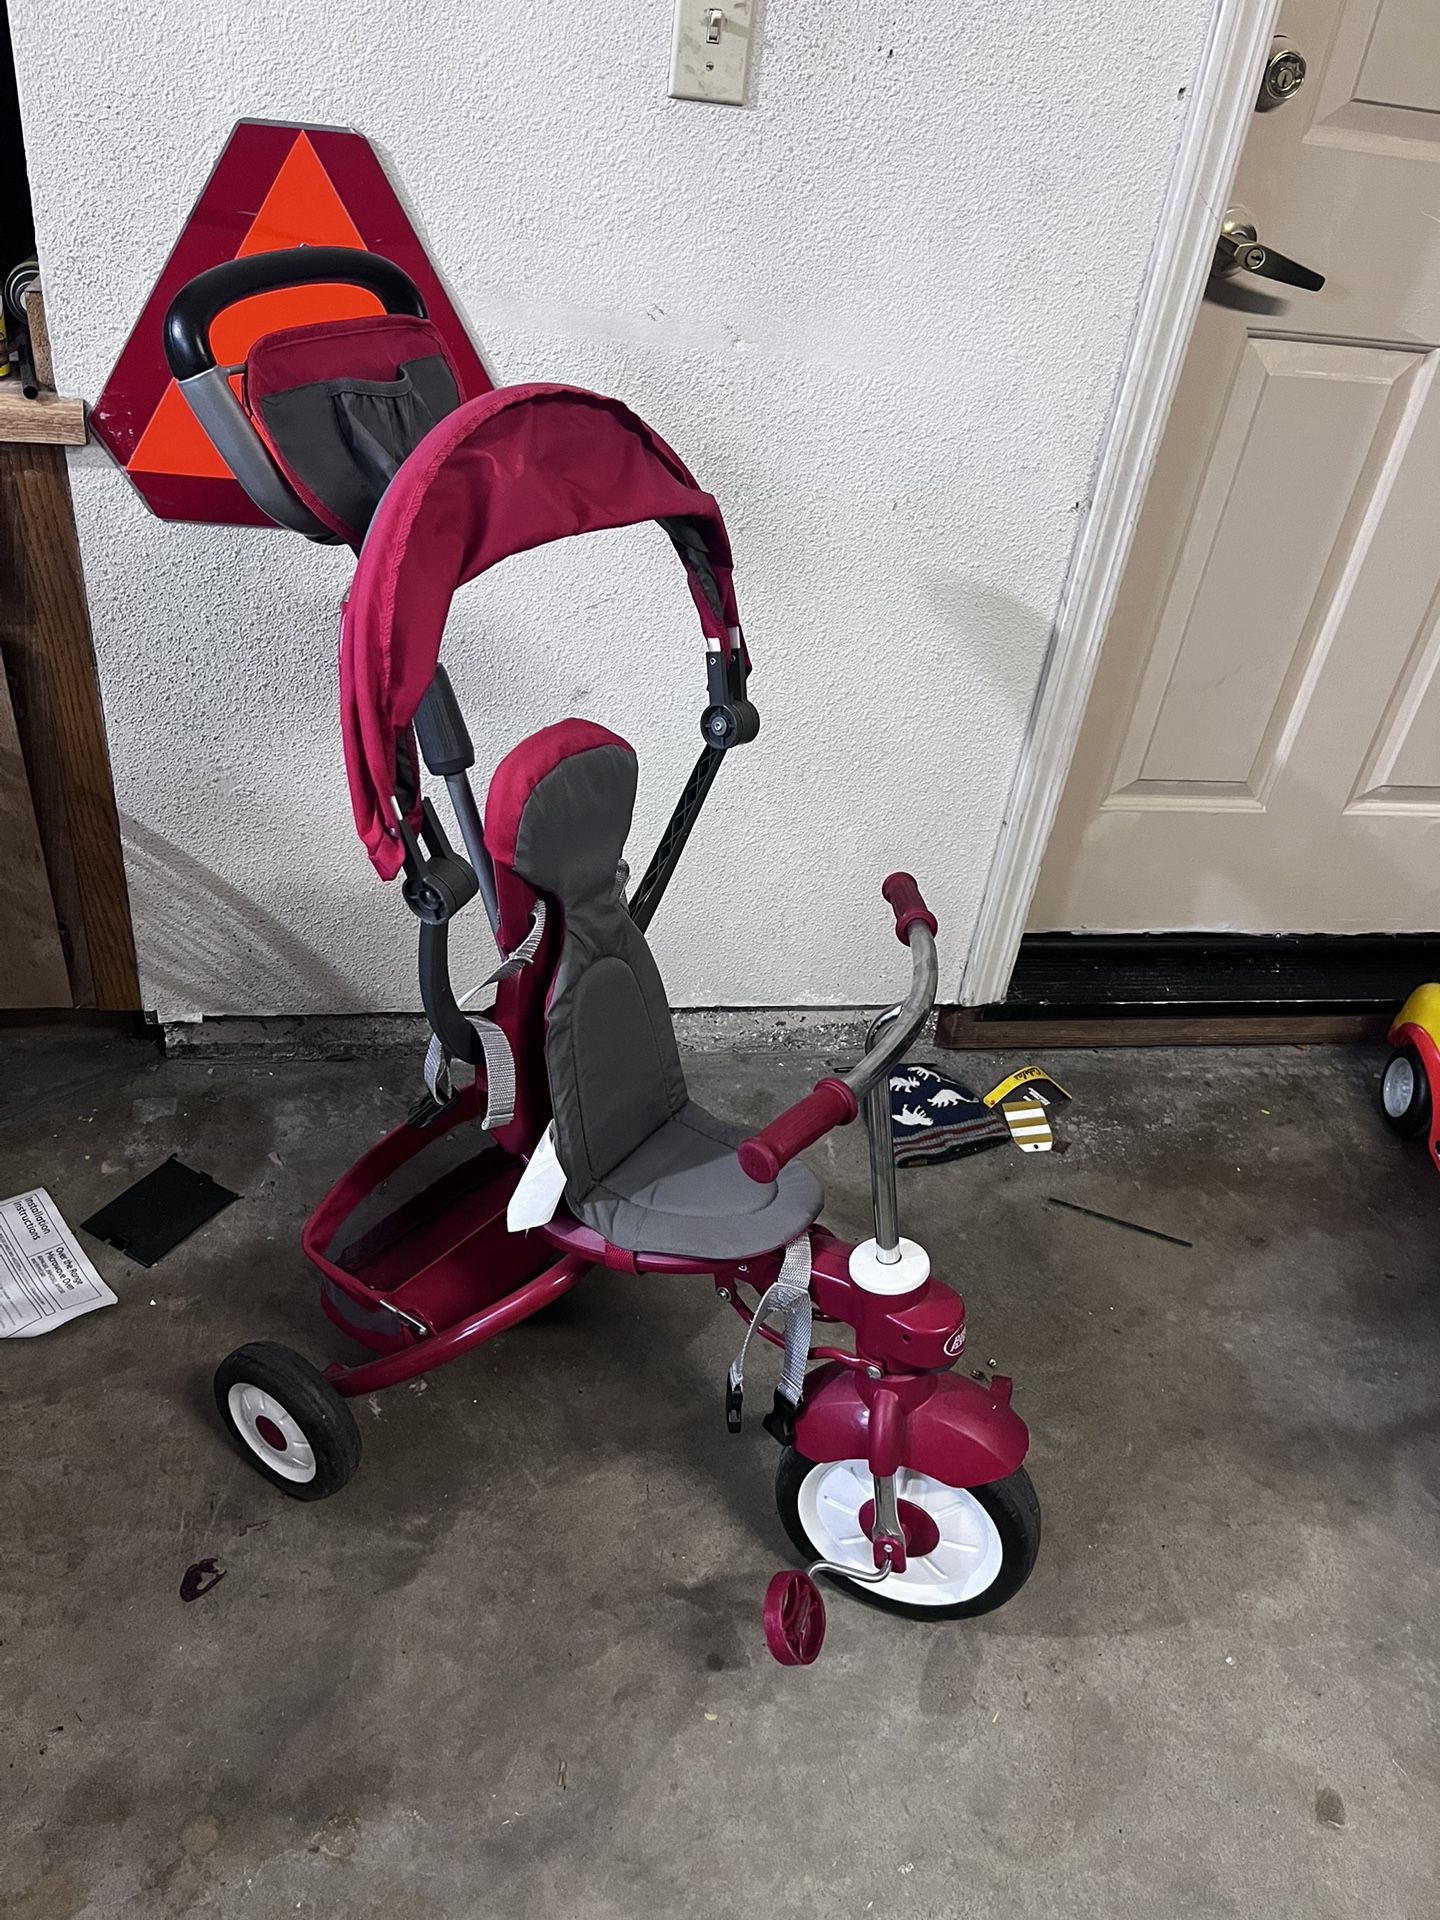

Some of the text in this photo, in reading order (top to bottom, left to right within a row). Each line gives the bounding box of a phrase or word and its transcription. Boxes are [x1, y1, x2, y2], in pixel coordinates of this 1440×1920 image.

[14, 1201, 41, 1241] Instructions
[25, 1196, 50, 1235] Installation
[45, 1250, 66, 1279] Microwave
[62, 1278, 75, 1290] Oven
[56, 1247, 83, 1285] Over the Range
